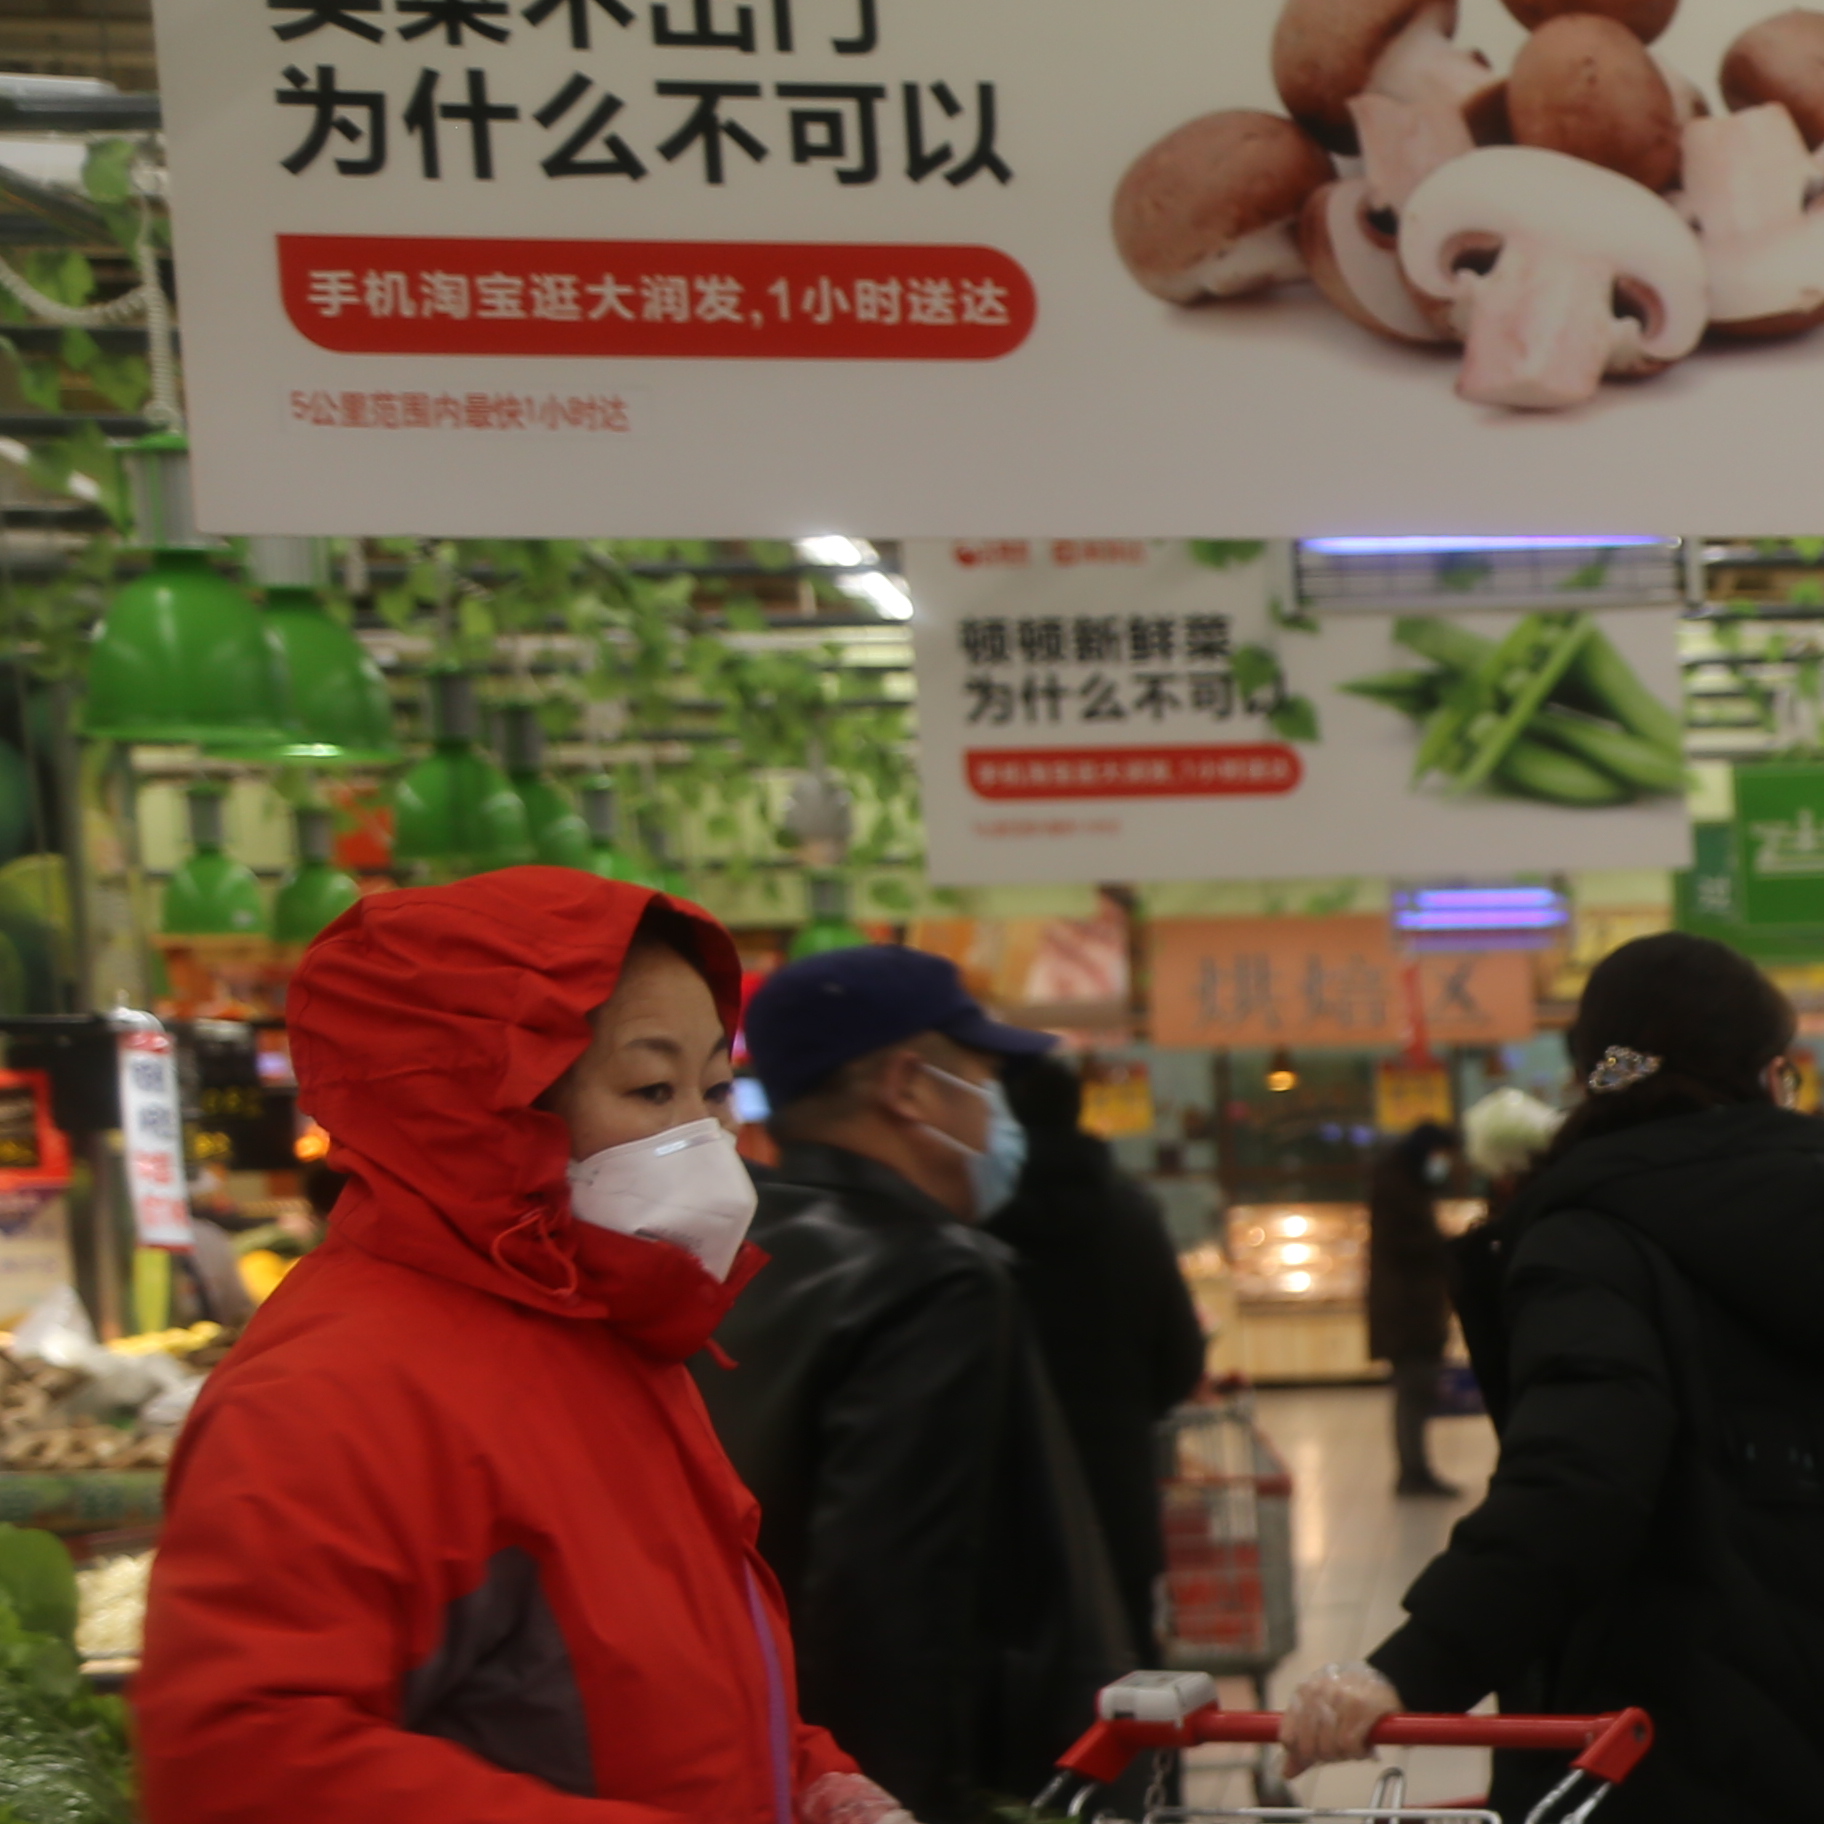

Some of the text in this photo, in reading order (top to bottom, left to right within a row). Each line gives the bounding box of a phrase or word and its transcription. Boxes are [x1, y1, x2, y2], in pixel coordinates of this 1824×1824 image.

[274, 65, 1014, 187] 为什么不可以
[960, 614, 1232, 664] 顿顿新鲜菜
